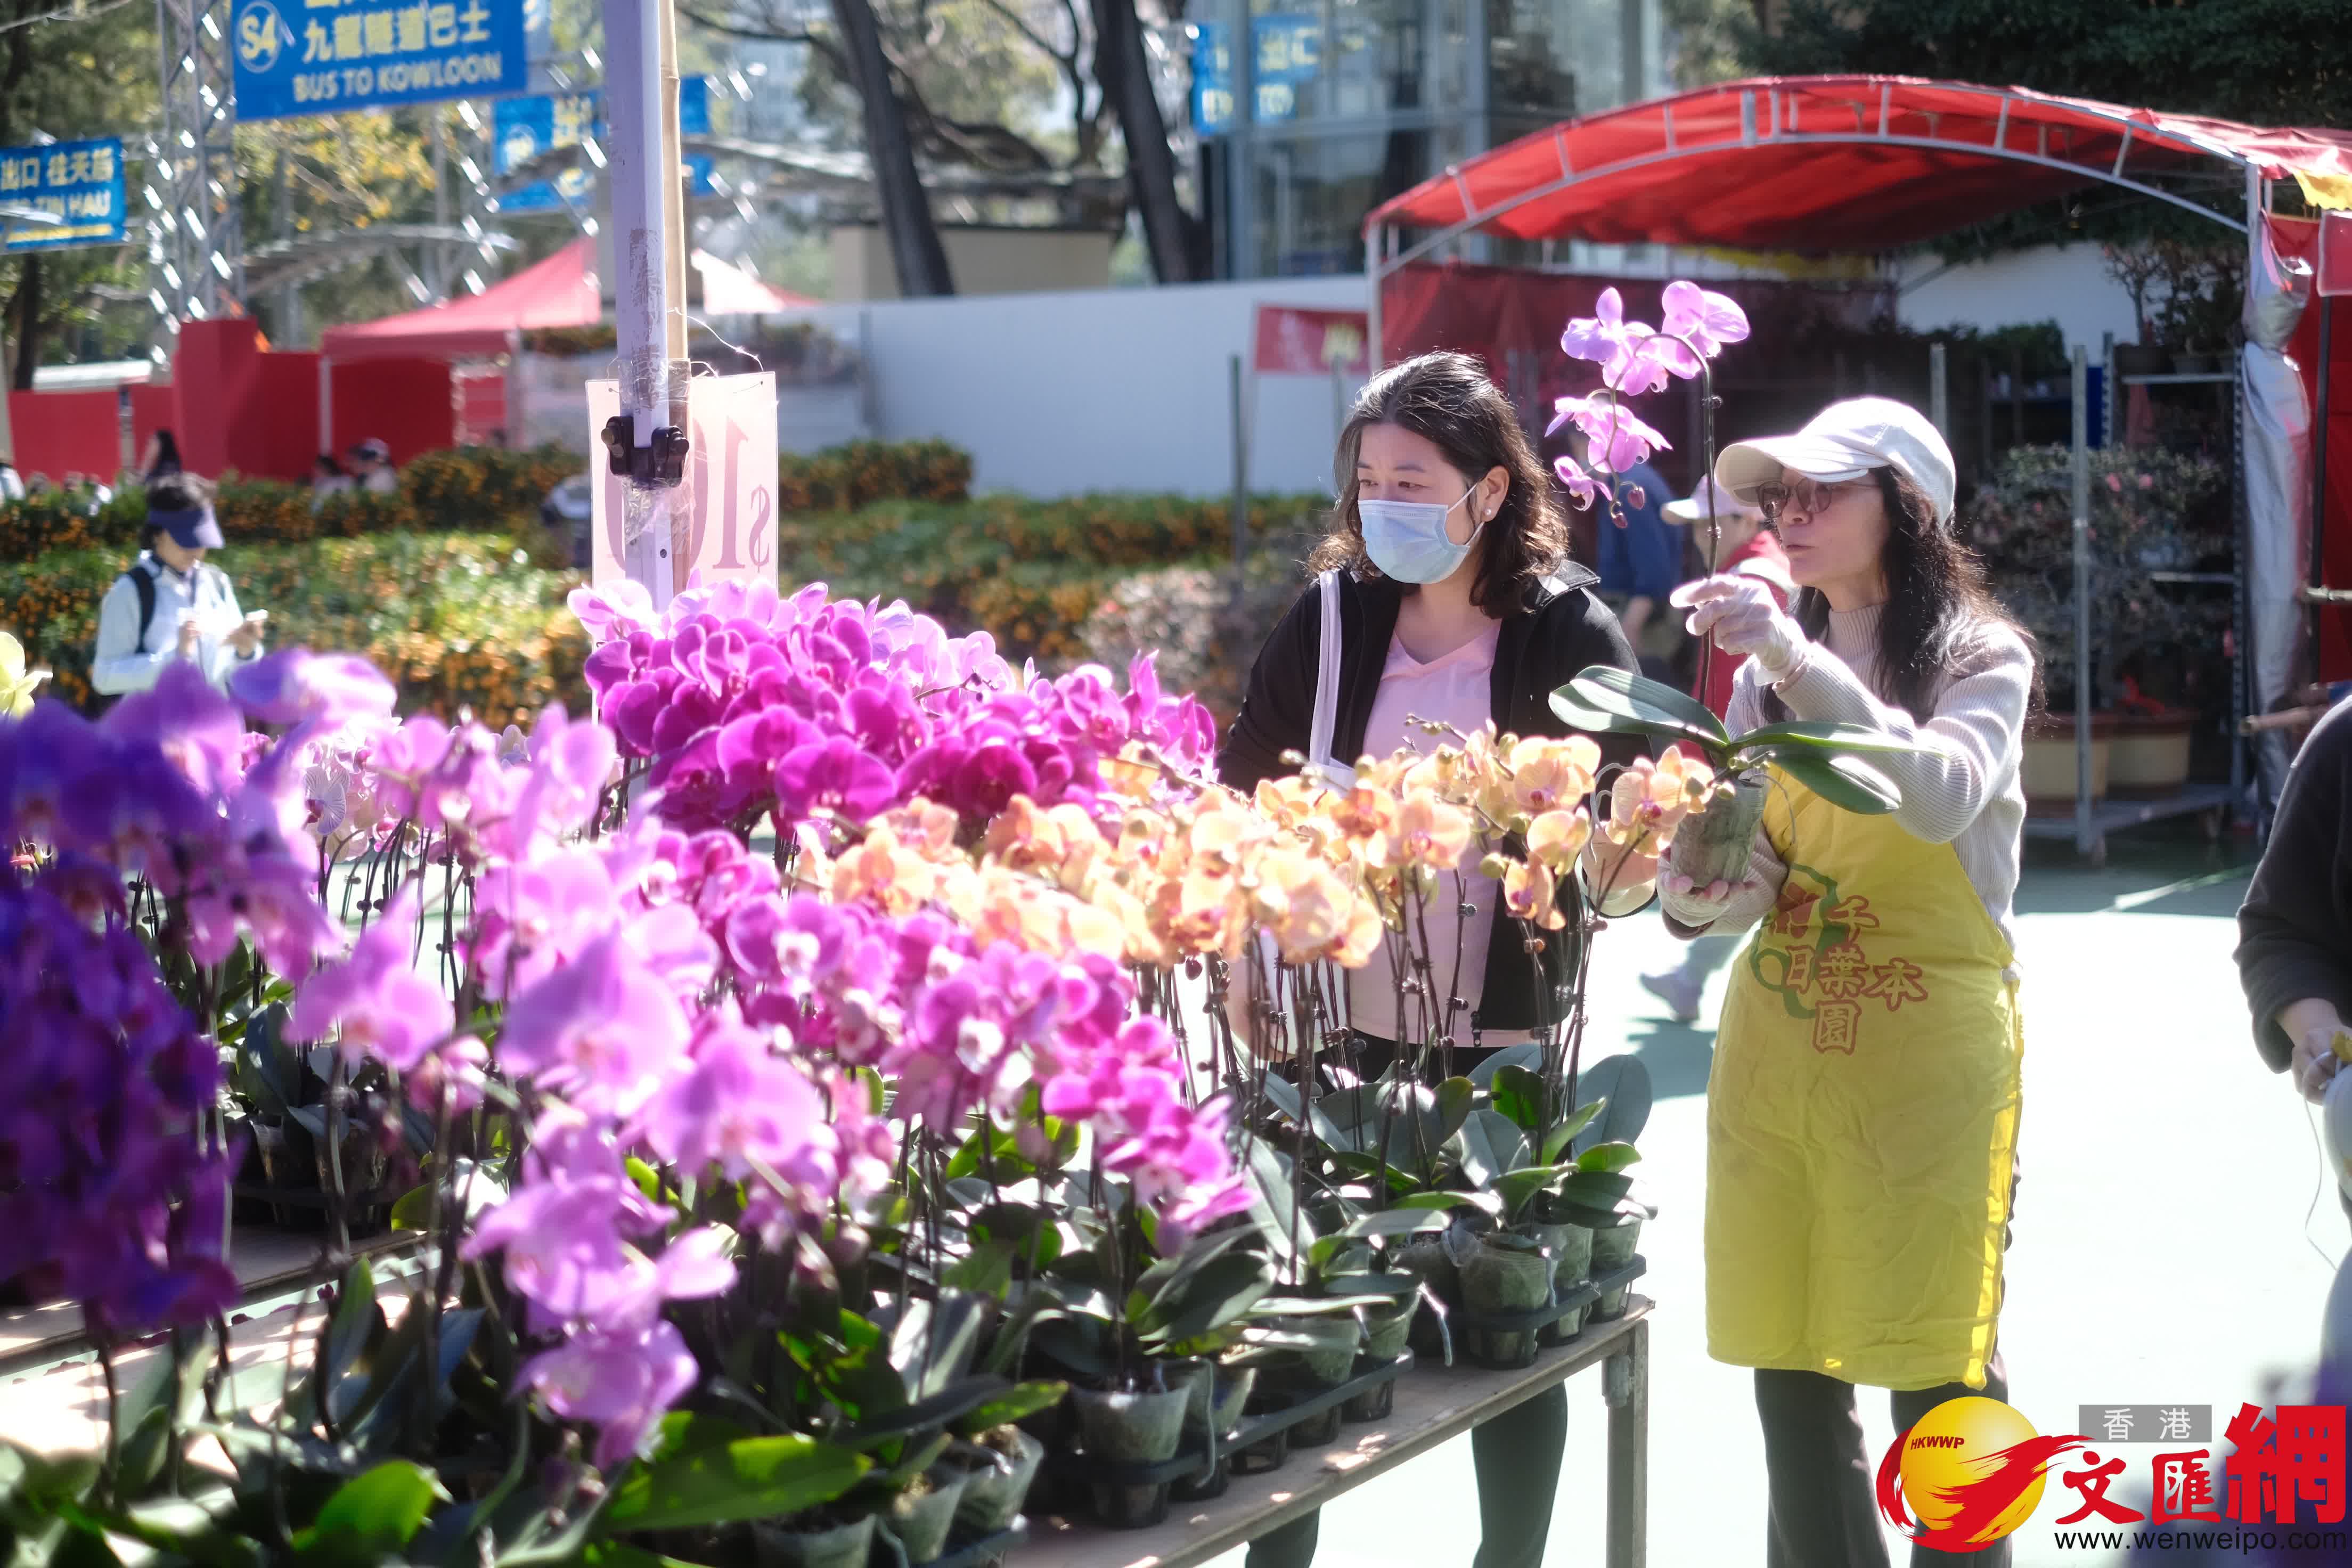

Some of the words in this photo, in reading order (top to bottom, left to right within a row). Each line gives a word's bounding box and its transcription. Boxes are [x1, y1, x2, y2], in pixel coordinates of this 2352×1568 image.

[240, 14, 277, 59] S4
[293, 71, 339, 103] BUS
[344, 66, 373, 96] TO
[377, 52, 501, 93] KOWLOON
